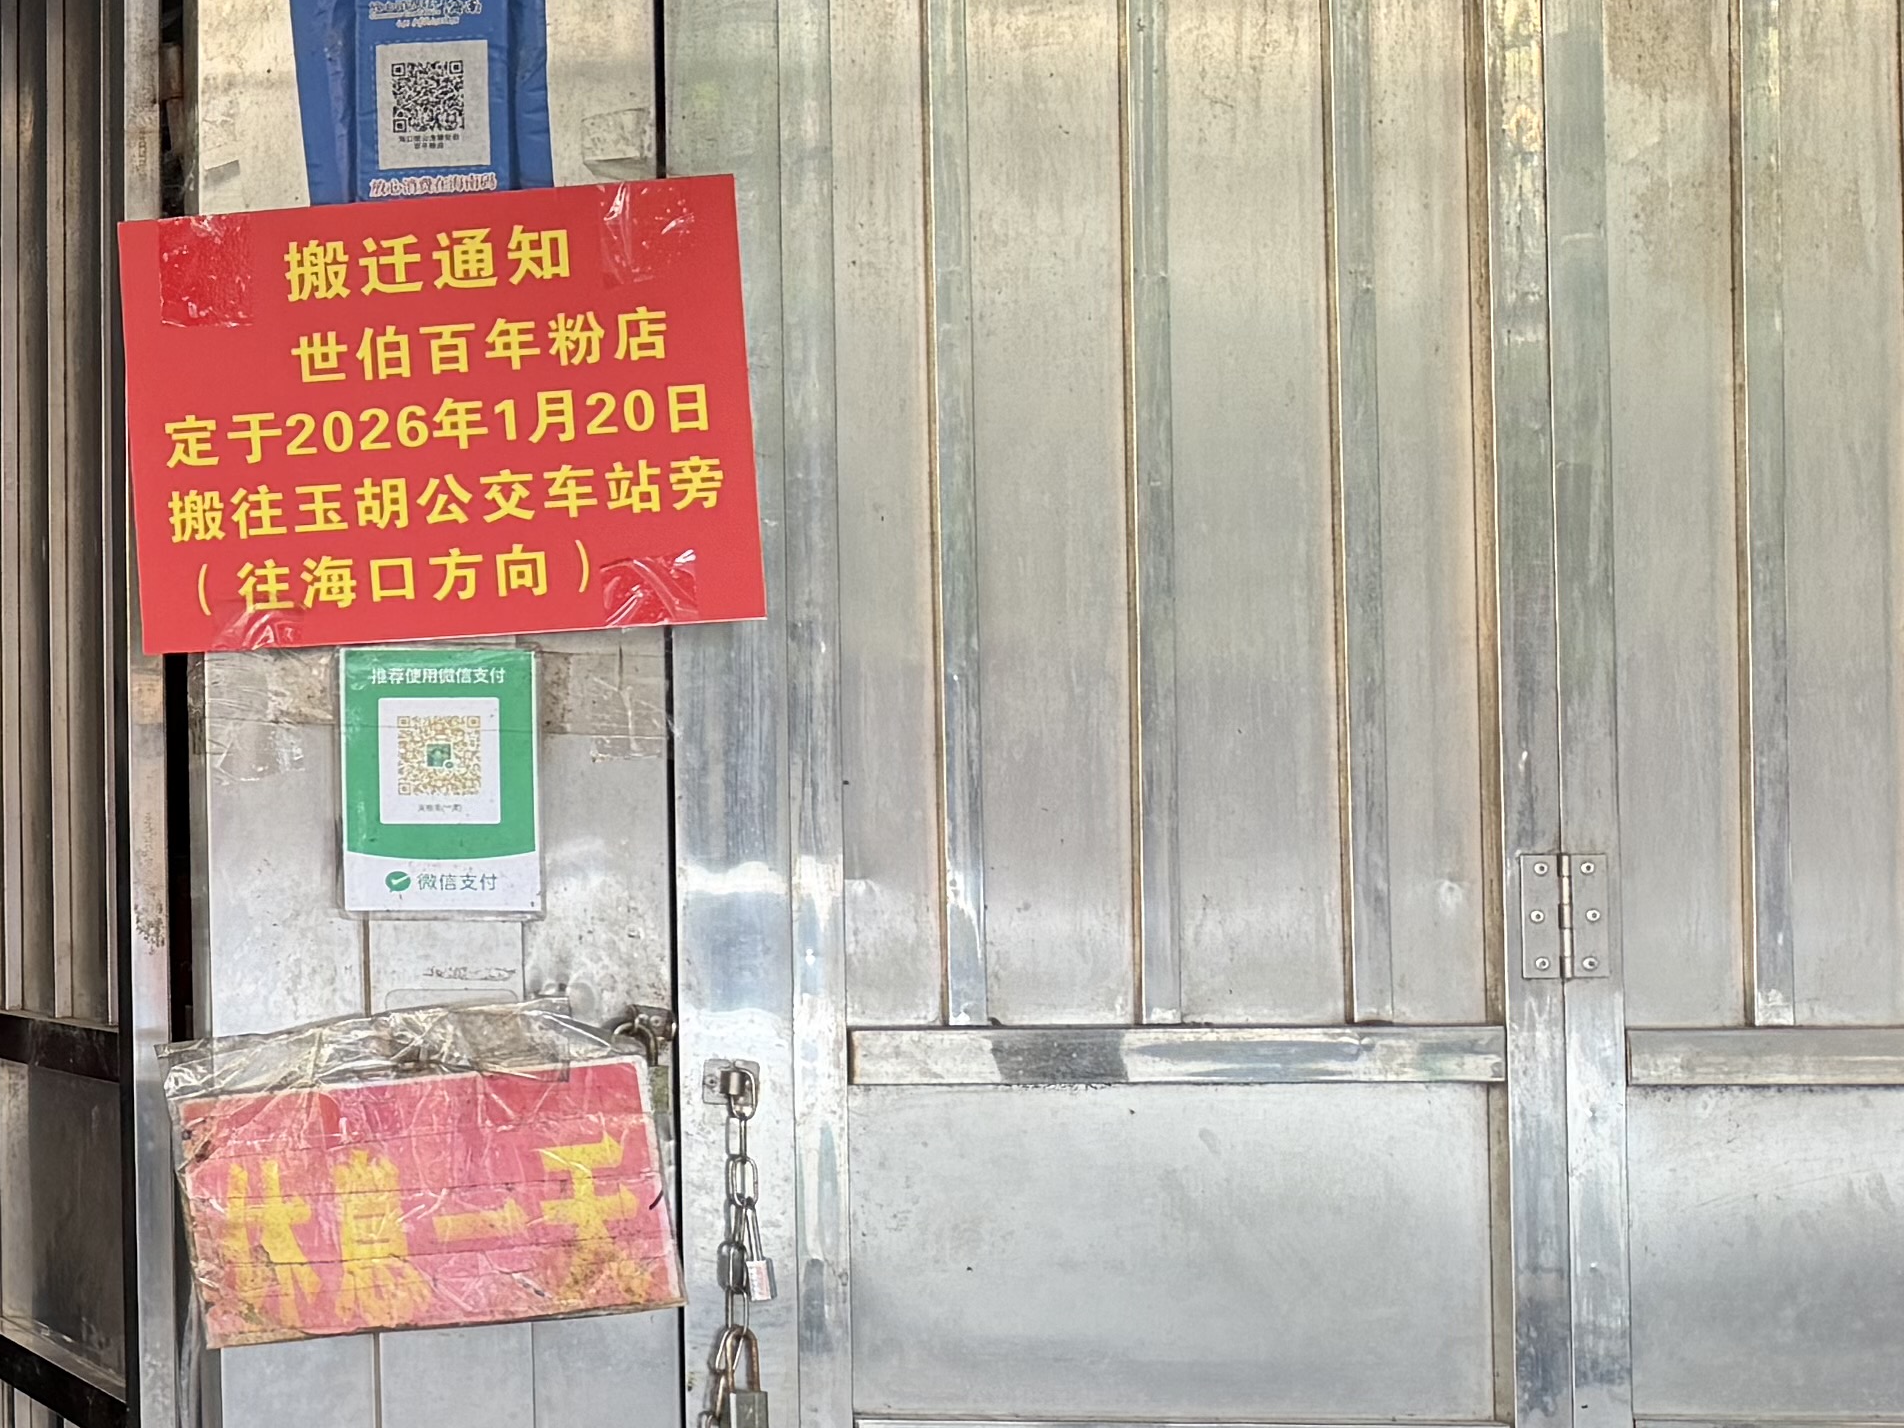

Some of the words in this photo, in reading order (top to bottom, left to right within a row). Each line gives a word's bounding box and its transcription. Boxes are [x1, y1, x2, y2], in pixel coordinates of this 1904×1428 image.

[283, 225, 572, 303] 搬迁通知
[291, 307, 669, 385] 世伯百年粉店
[164, 384, 711, 469] 定于2026年1月20日
[167, 455, 726, 544] 搬往玉胡公交车站旁
[370, 666, 506, 686] 推荐使用微信支付
[416, 871, 498, 893] 微信支付
